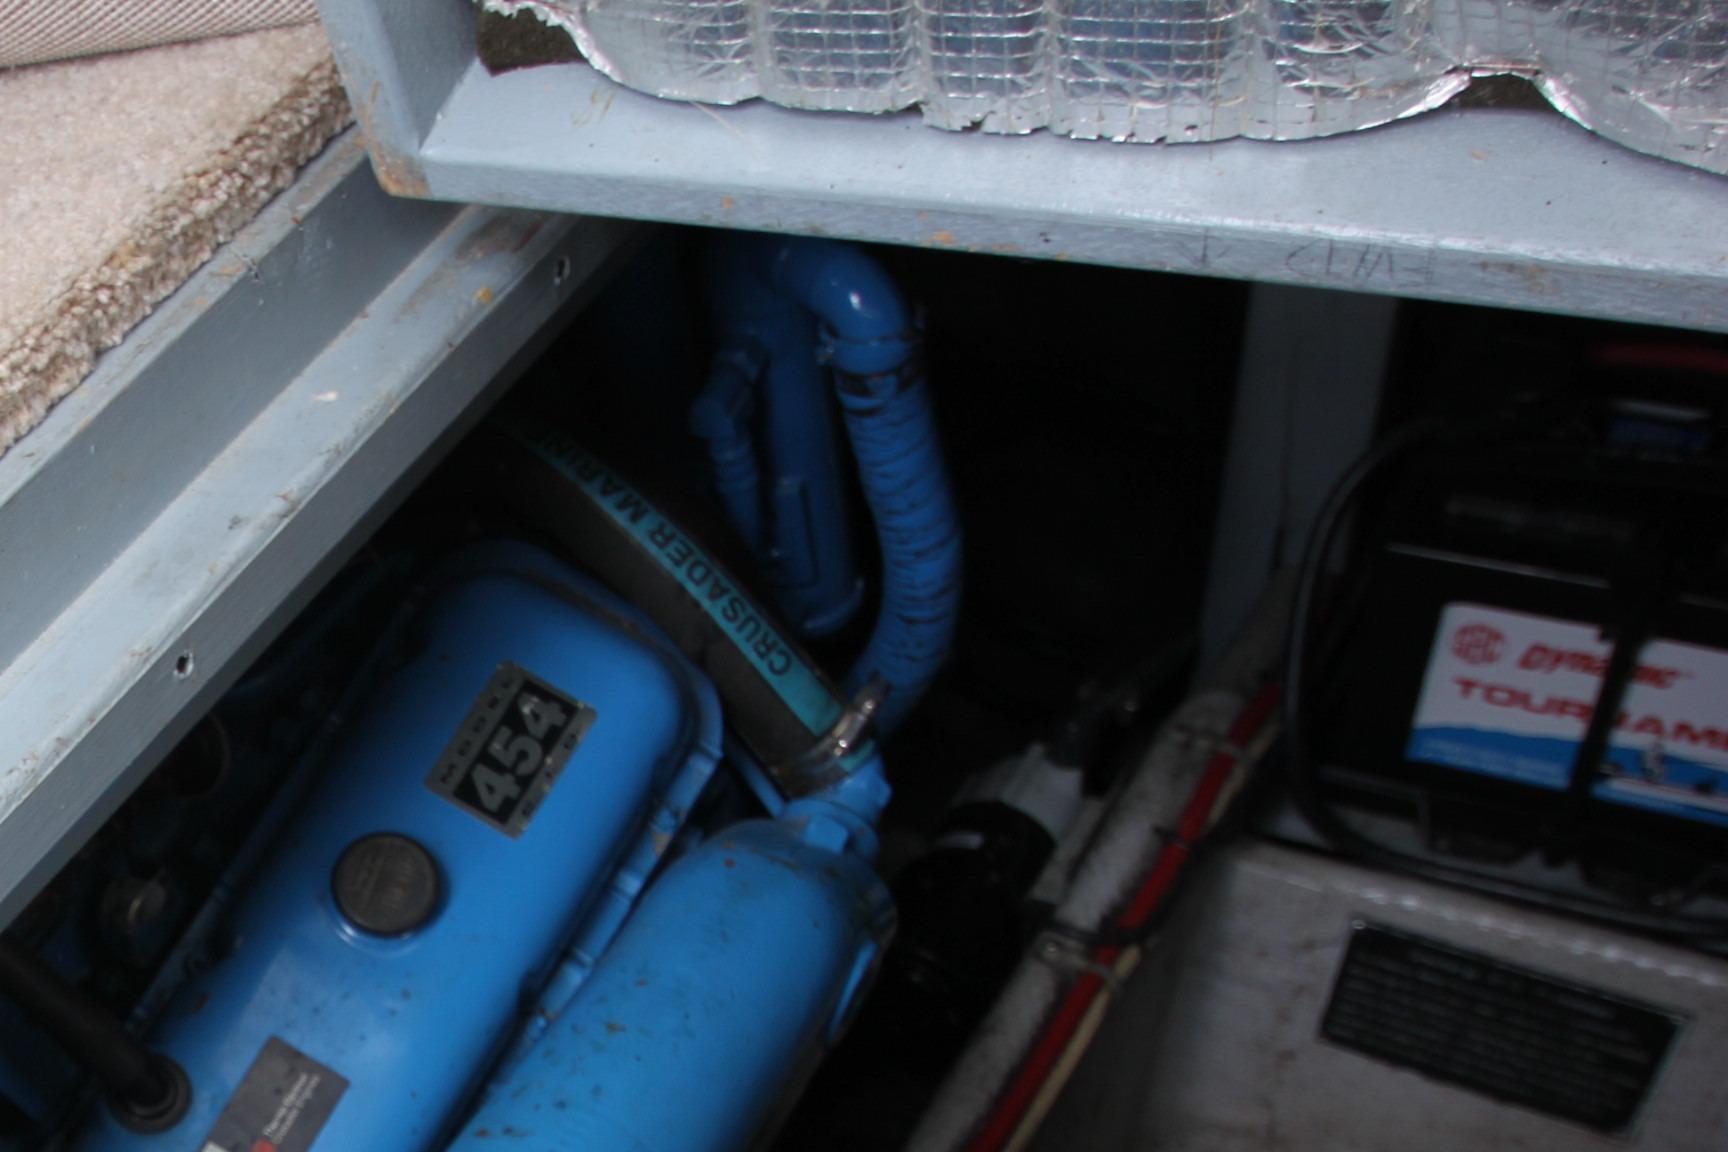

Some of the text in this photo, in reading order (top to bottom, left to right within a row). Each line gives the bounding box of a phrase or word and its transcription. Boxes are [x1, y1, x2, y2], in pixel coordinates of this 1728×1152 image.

[648, 515, 793, 677] CRUSADER
[471, 691, 568, 814] 454
[1452, 676, 1728, 750] TOURAM
